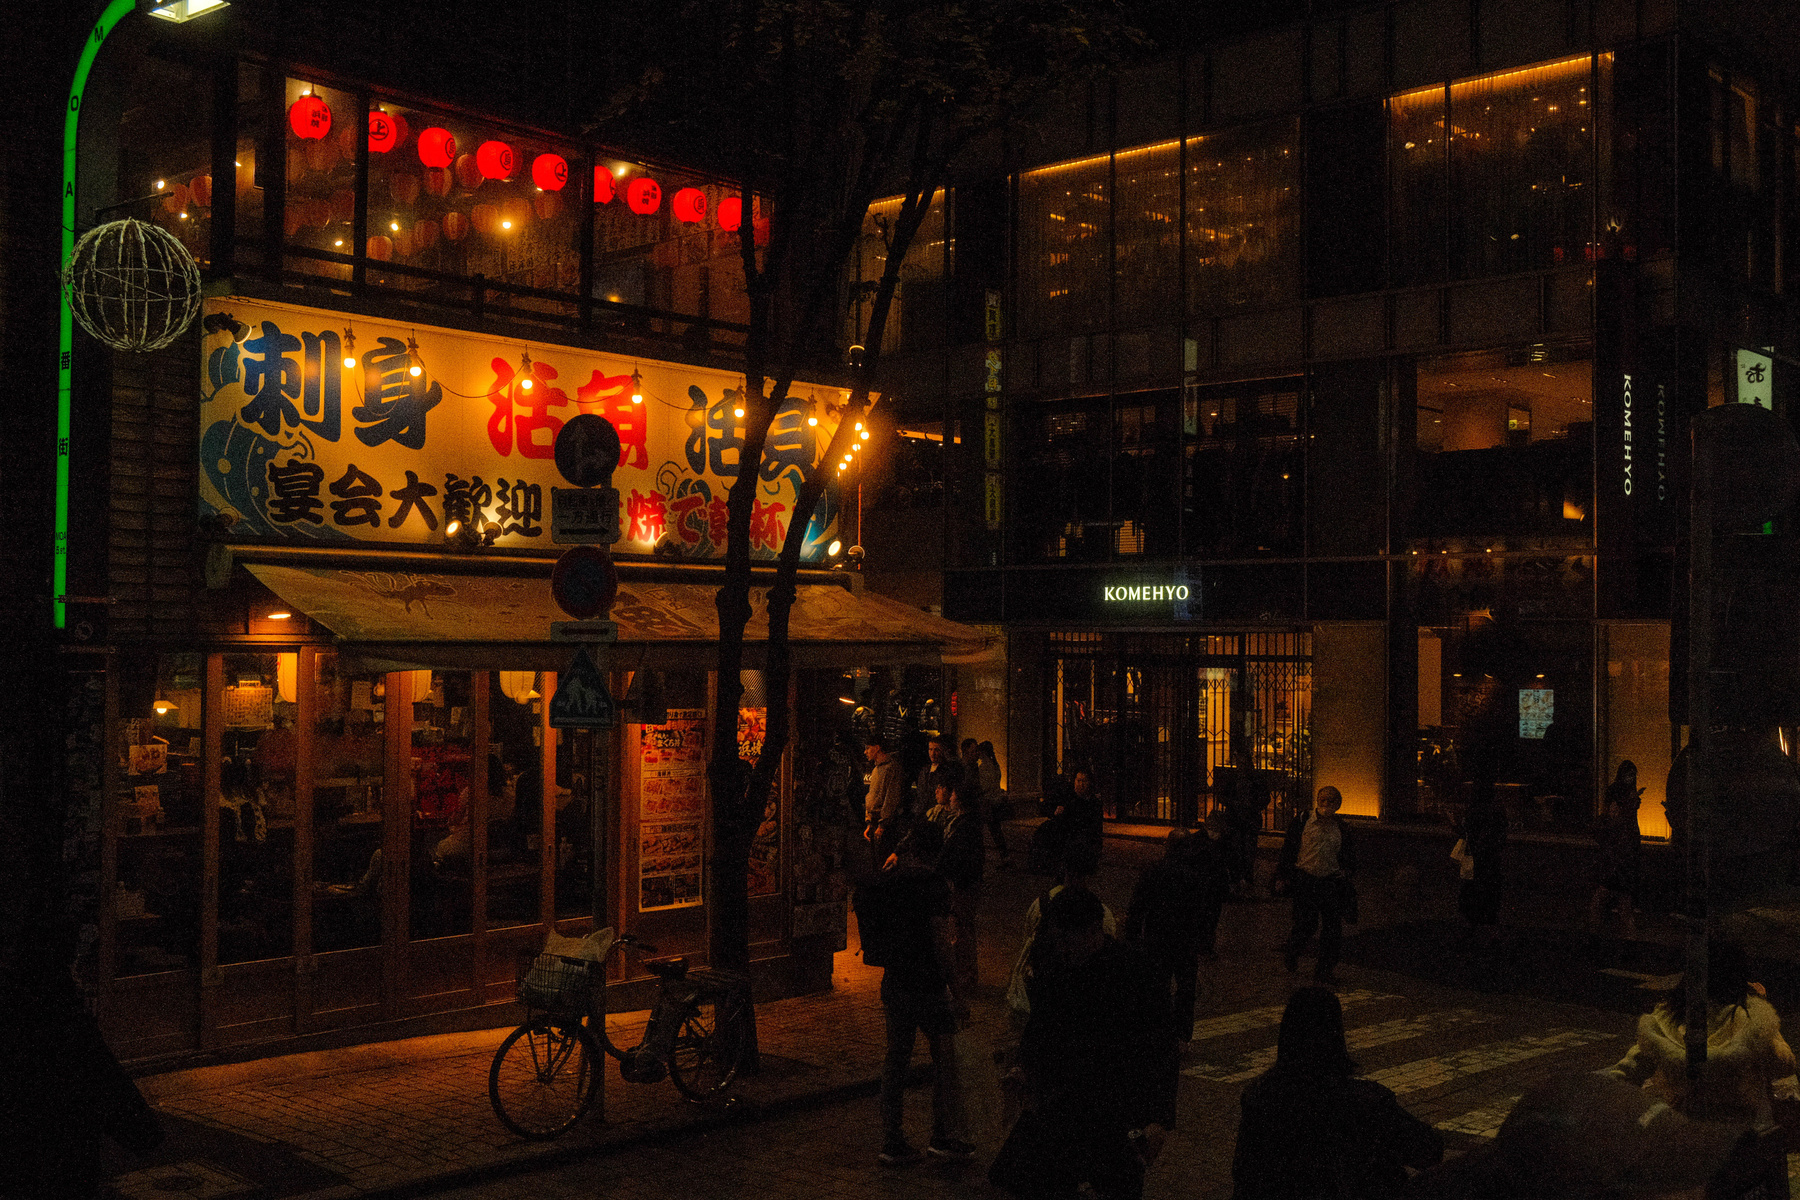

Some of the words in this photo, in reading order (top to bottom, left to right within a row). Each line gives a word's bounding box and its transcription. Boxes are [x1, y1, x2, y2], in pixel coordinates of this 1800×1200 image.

[240, 321, 443, 450] 刺身
[487, 357, 648, 470] 活魚
[1623, 374, 1632, 496] KOMEHYO
[267, 459, 543, 537] 宴会大歓迎
[557, 510, 613, 525] 一方通行
[1104, 585, 1189, 601] KOMEHYO
